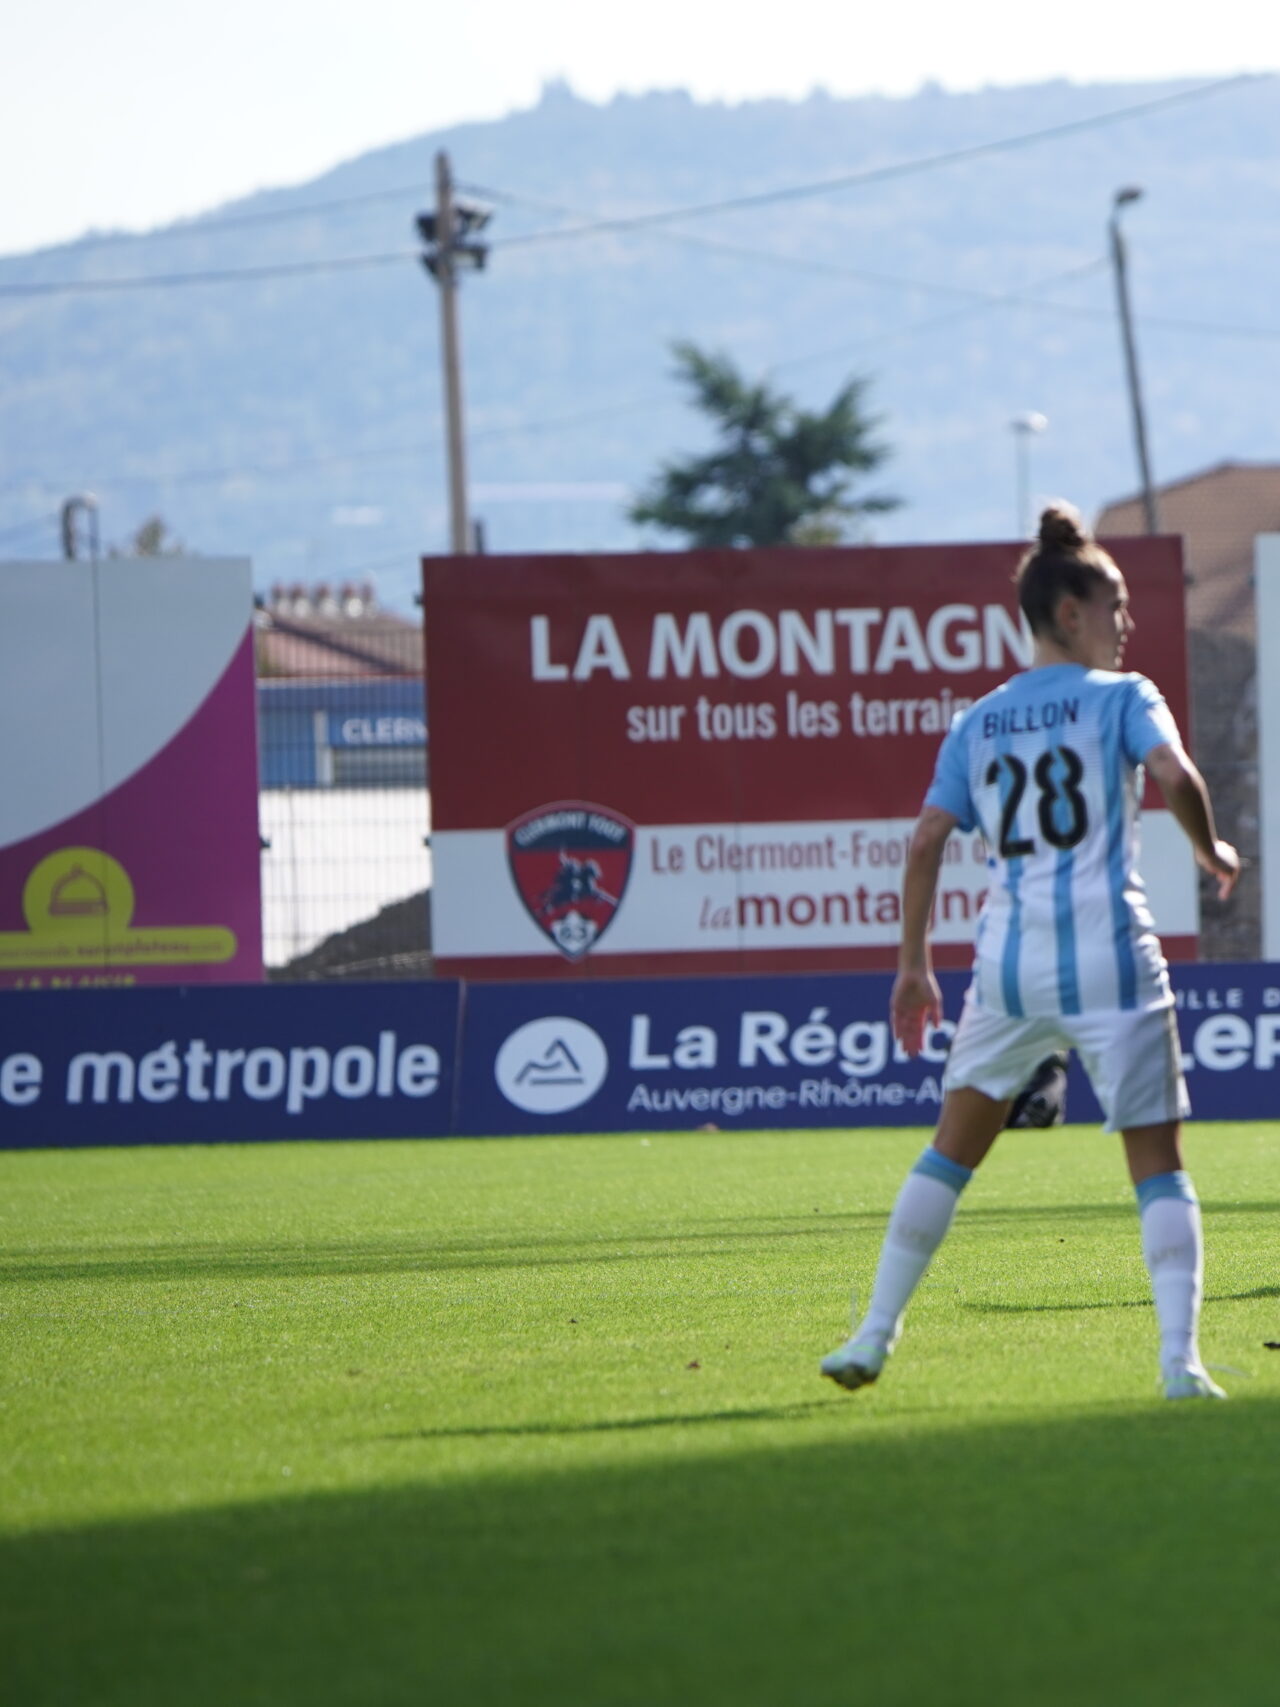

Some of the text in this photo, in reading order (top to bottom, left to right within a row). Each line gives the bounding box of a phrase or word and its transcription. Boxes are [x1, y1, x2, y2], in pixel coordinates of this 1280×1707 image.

[530, 603, 1036, 682] LA MONTAGN
[626, 687, 974, 742] sur tous les terrai
[983, 699, 1080, 740] BILLON
[986, 745, 1089, 857] 28
[651, 837, 684, 873] Le
[736, 884, 989, 928] montan
[1175, 988, 1244, 1010] ILLE
[629, 1006, 958, 1078] La Régo
[66, 1030, 440, 1114] métropole
[626, 1074, 943, 1116] Auvergne-Rhône-A
